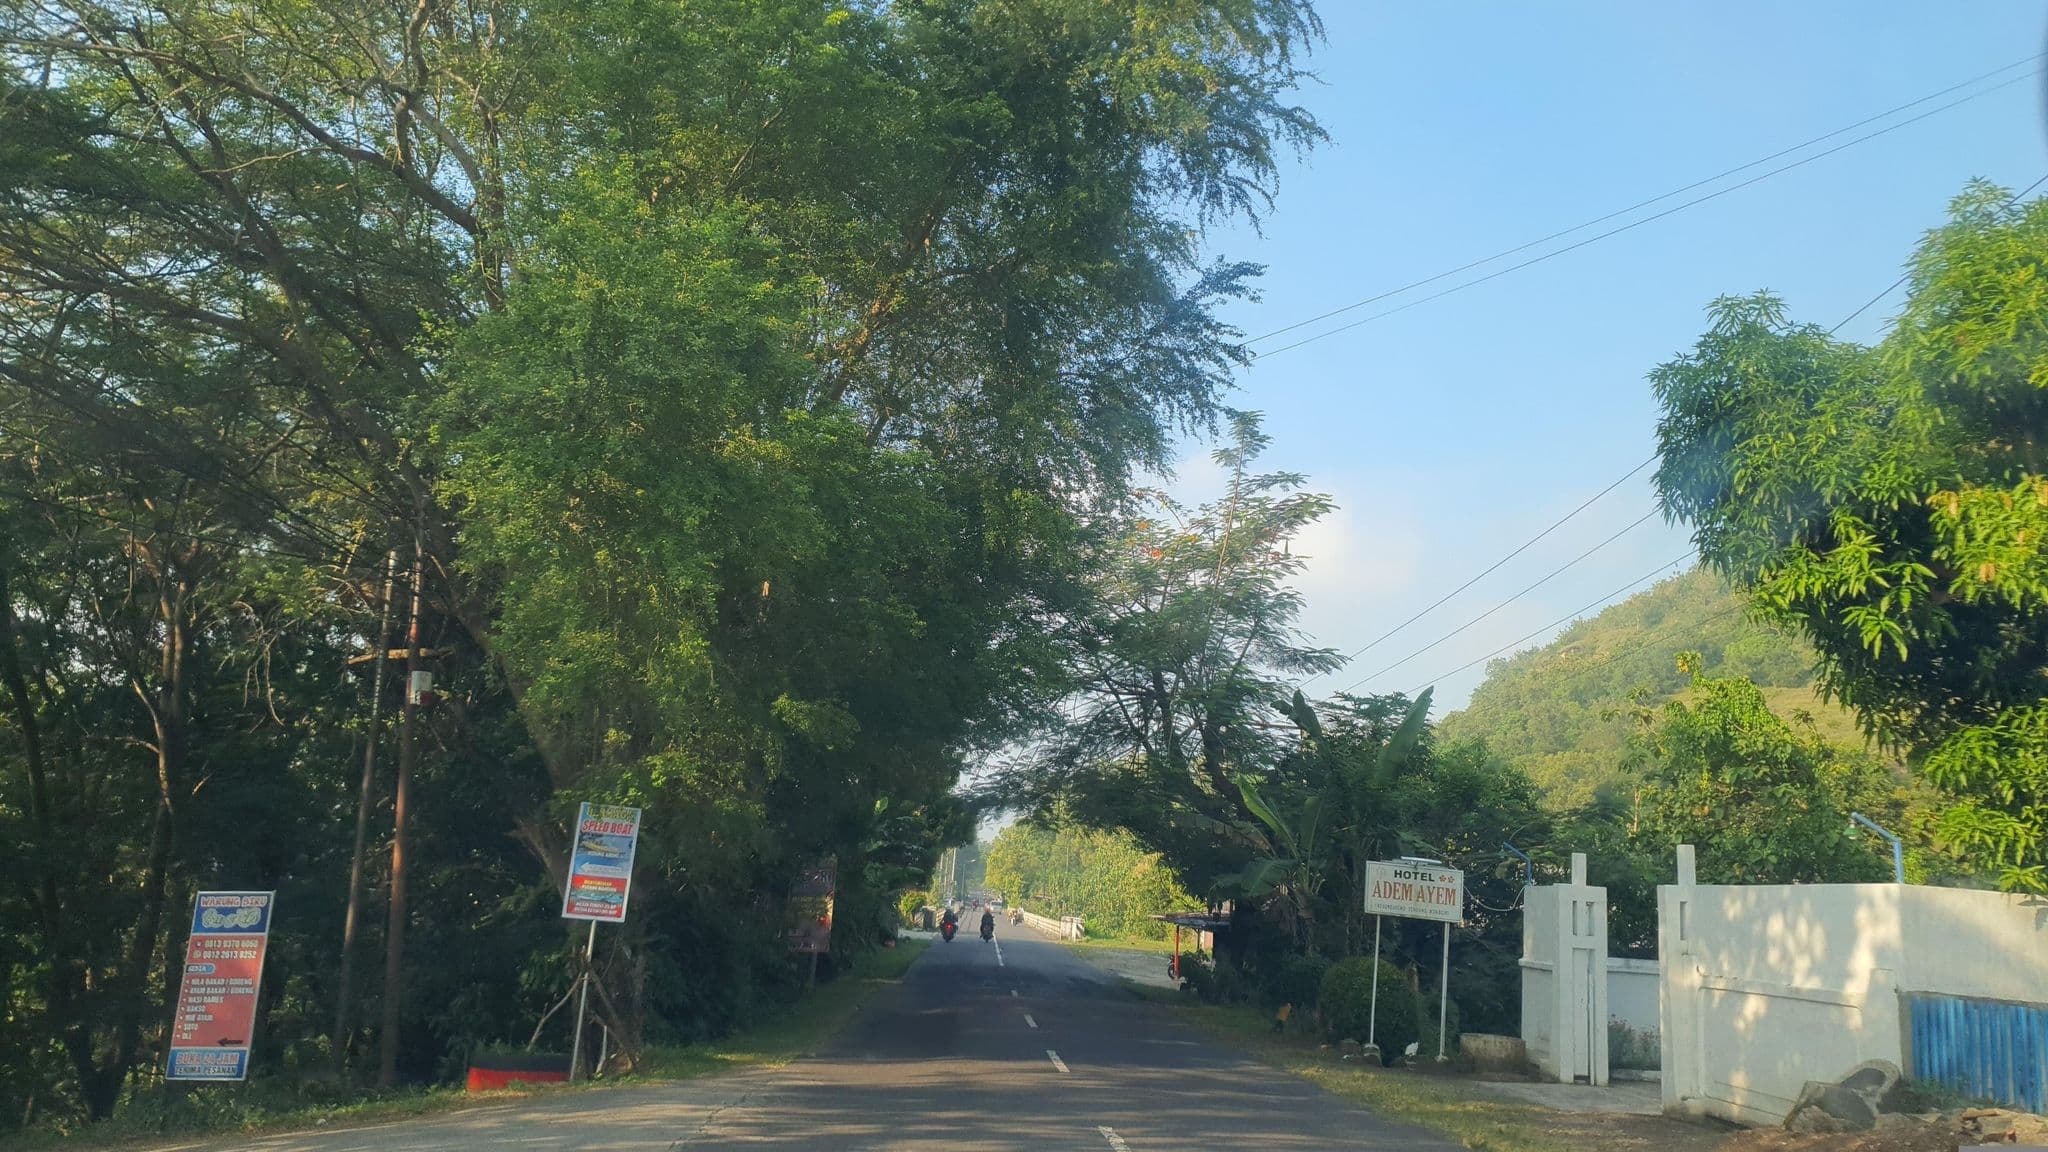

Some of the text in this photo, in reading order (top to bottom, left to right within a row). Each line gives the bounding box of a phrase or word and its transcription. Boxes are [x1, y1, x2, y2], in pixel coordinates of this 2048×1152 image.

[582, 819, 633, 834] SPEED BOAT
[1394, 869, 1435, 882] HOTEL
[1372, 880, 1457, 906] ADEM AYEM
[201, 896, 240, 907] WARUNG
[203, 951, 219, 959] 0812
[175, 1052, 200, 1065] BUKA
[216, 1052, 240, 1065] JAM
